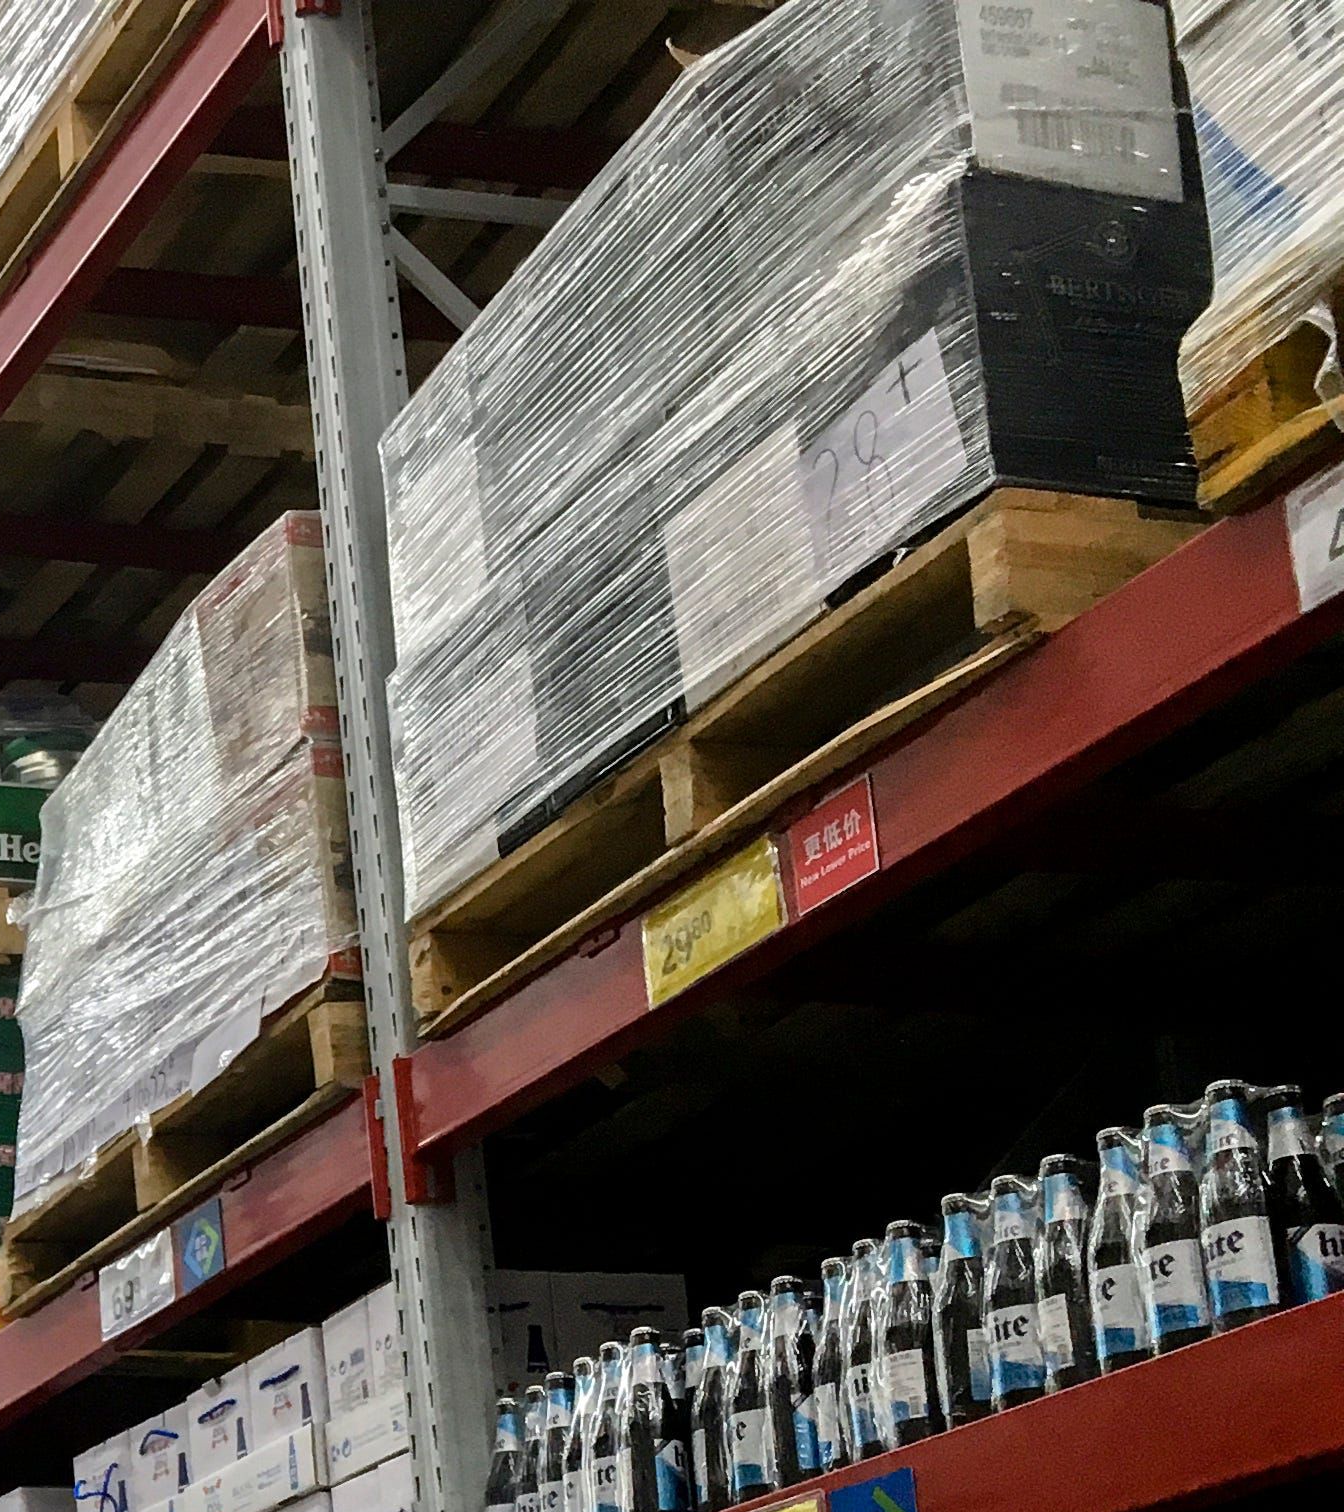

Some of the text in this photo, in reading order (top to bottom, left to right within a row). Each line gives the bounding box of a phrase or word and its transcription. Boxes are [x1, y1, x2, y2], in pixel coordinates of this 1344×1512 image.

[799, 839, 872, 889] New Lower Price
[802, 808, 862, 866] 更低价
